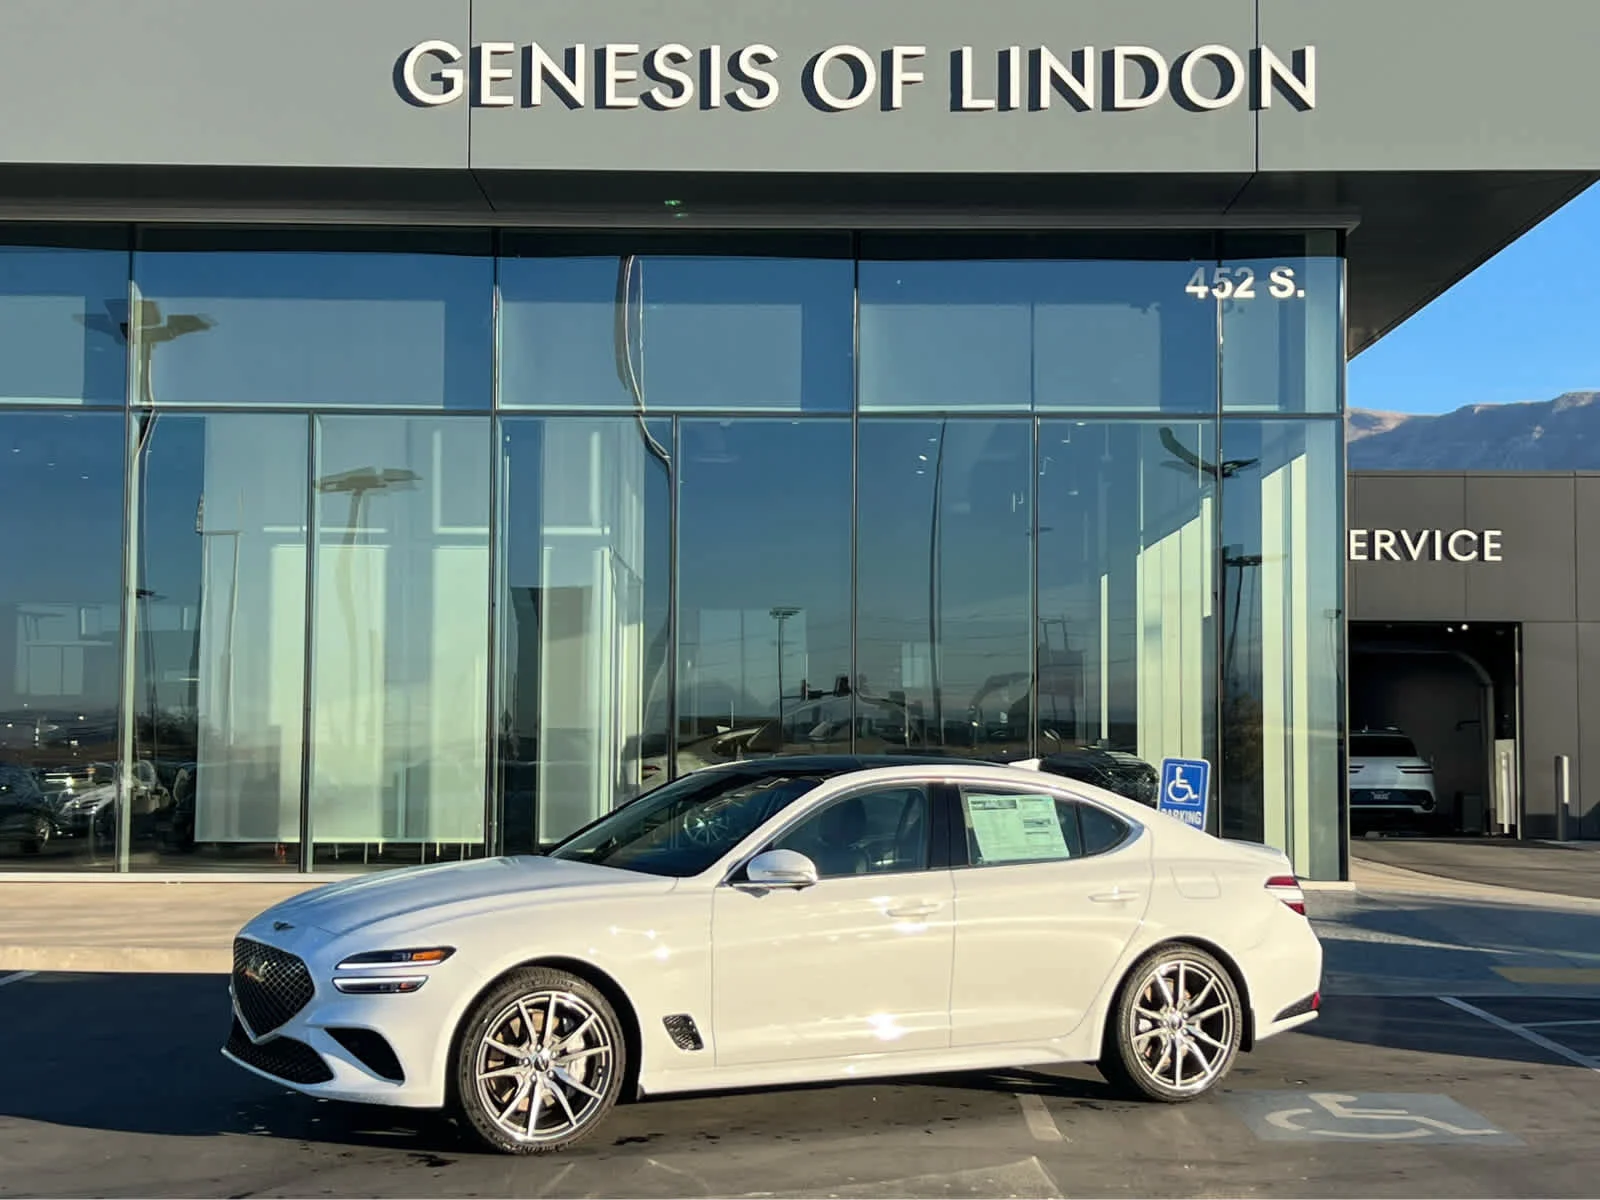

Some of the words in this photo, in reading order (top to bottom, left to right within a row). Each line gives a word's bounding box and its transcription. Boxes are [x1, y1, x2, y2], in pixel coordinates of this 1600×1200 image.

[402, 40, 779, 110] GENESIS
[812, 44, 926, 110] OF
[961, 44, 1316, 110] LINDON
[1185, 266, 1256, 299] 452
[1268, 265, 1305, 298] S.
